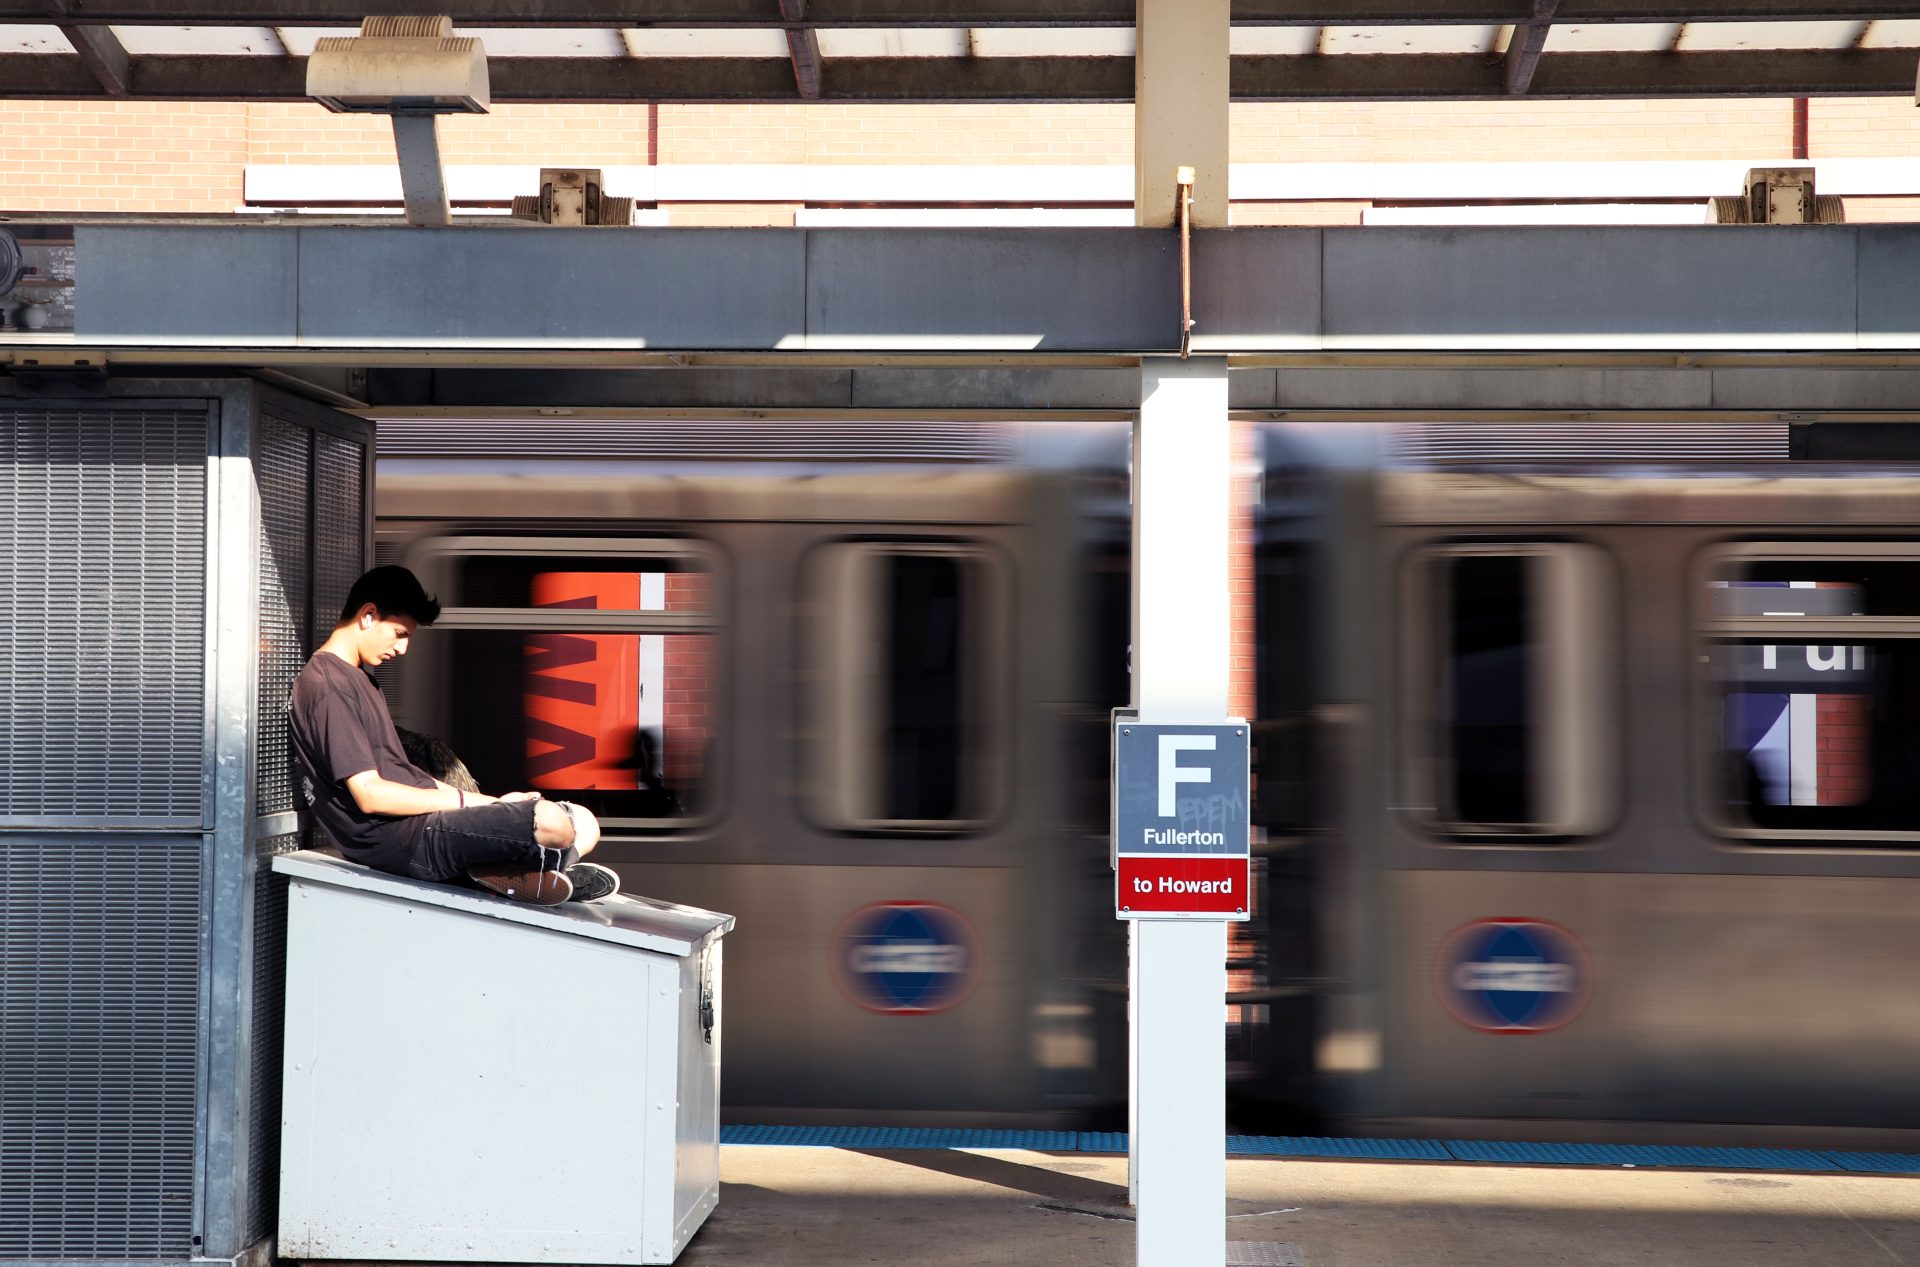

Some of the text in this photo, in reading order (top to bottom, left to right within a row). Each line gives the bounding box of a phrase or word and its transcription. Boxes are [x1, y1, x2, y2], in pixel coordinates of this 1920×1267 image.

[1158, 734, 1217, 817] F
[1144, 828, 1224, 845] Fullerton
[1133, 876, 1232, 894] to Howard
